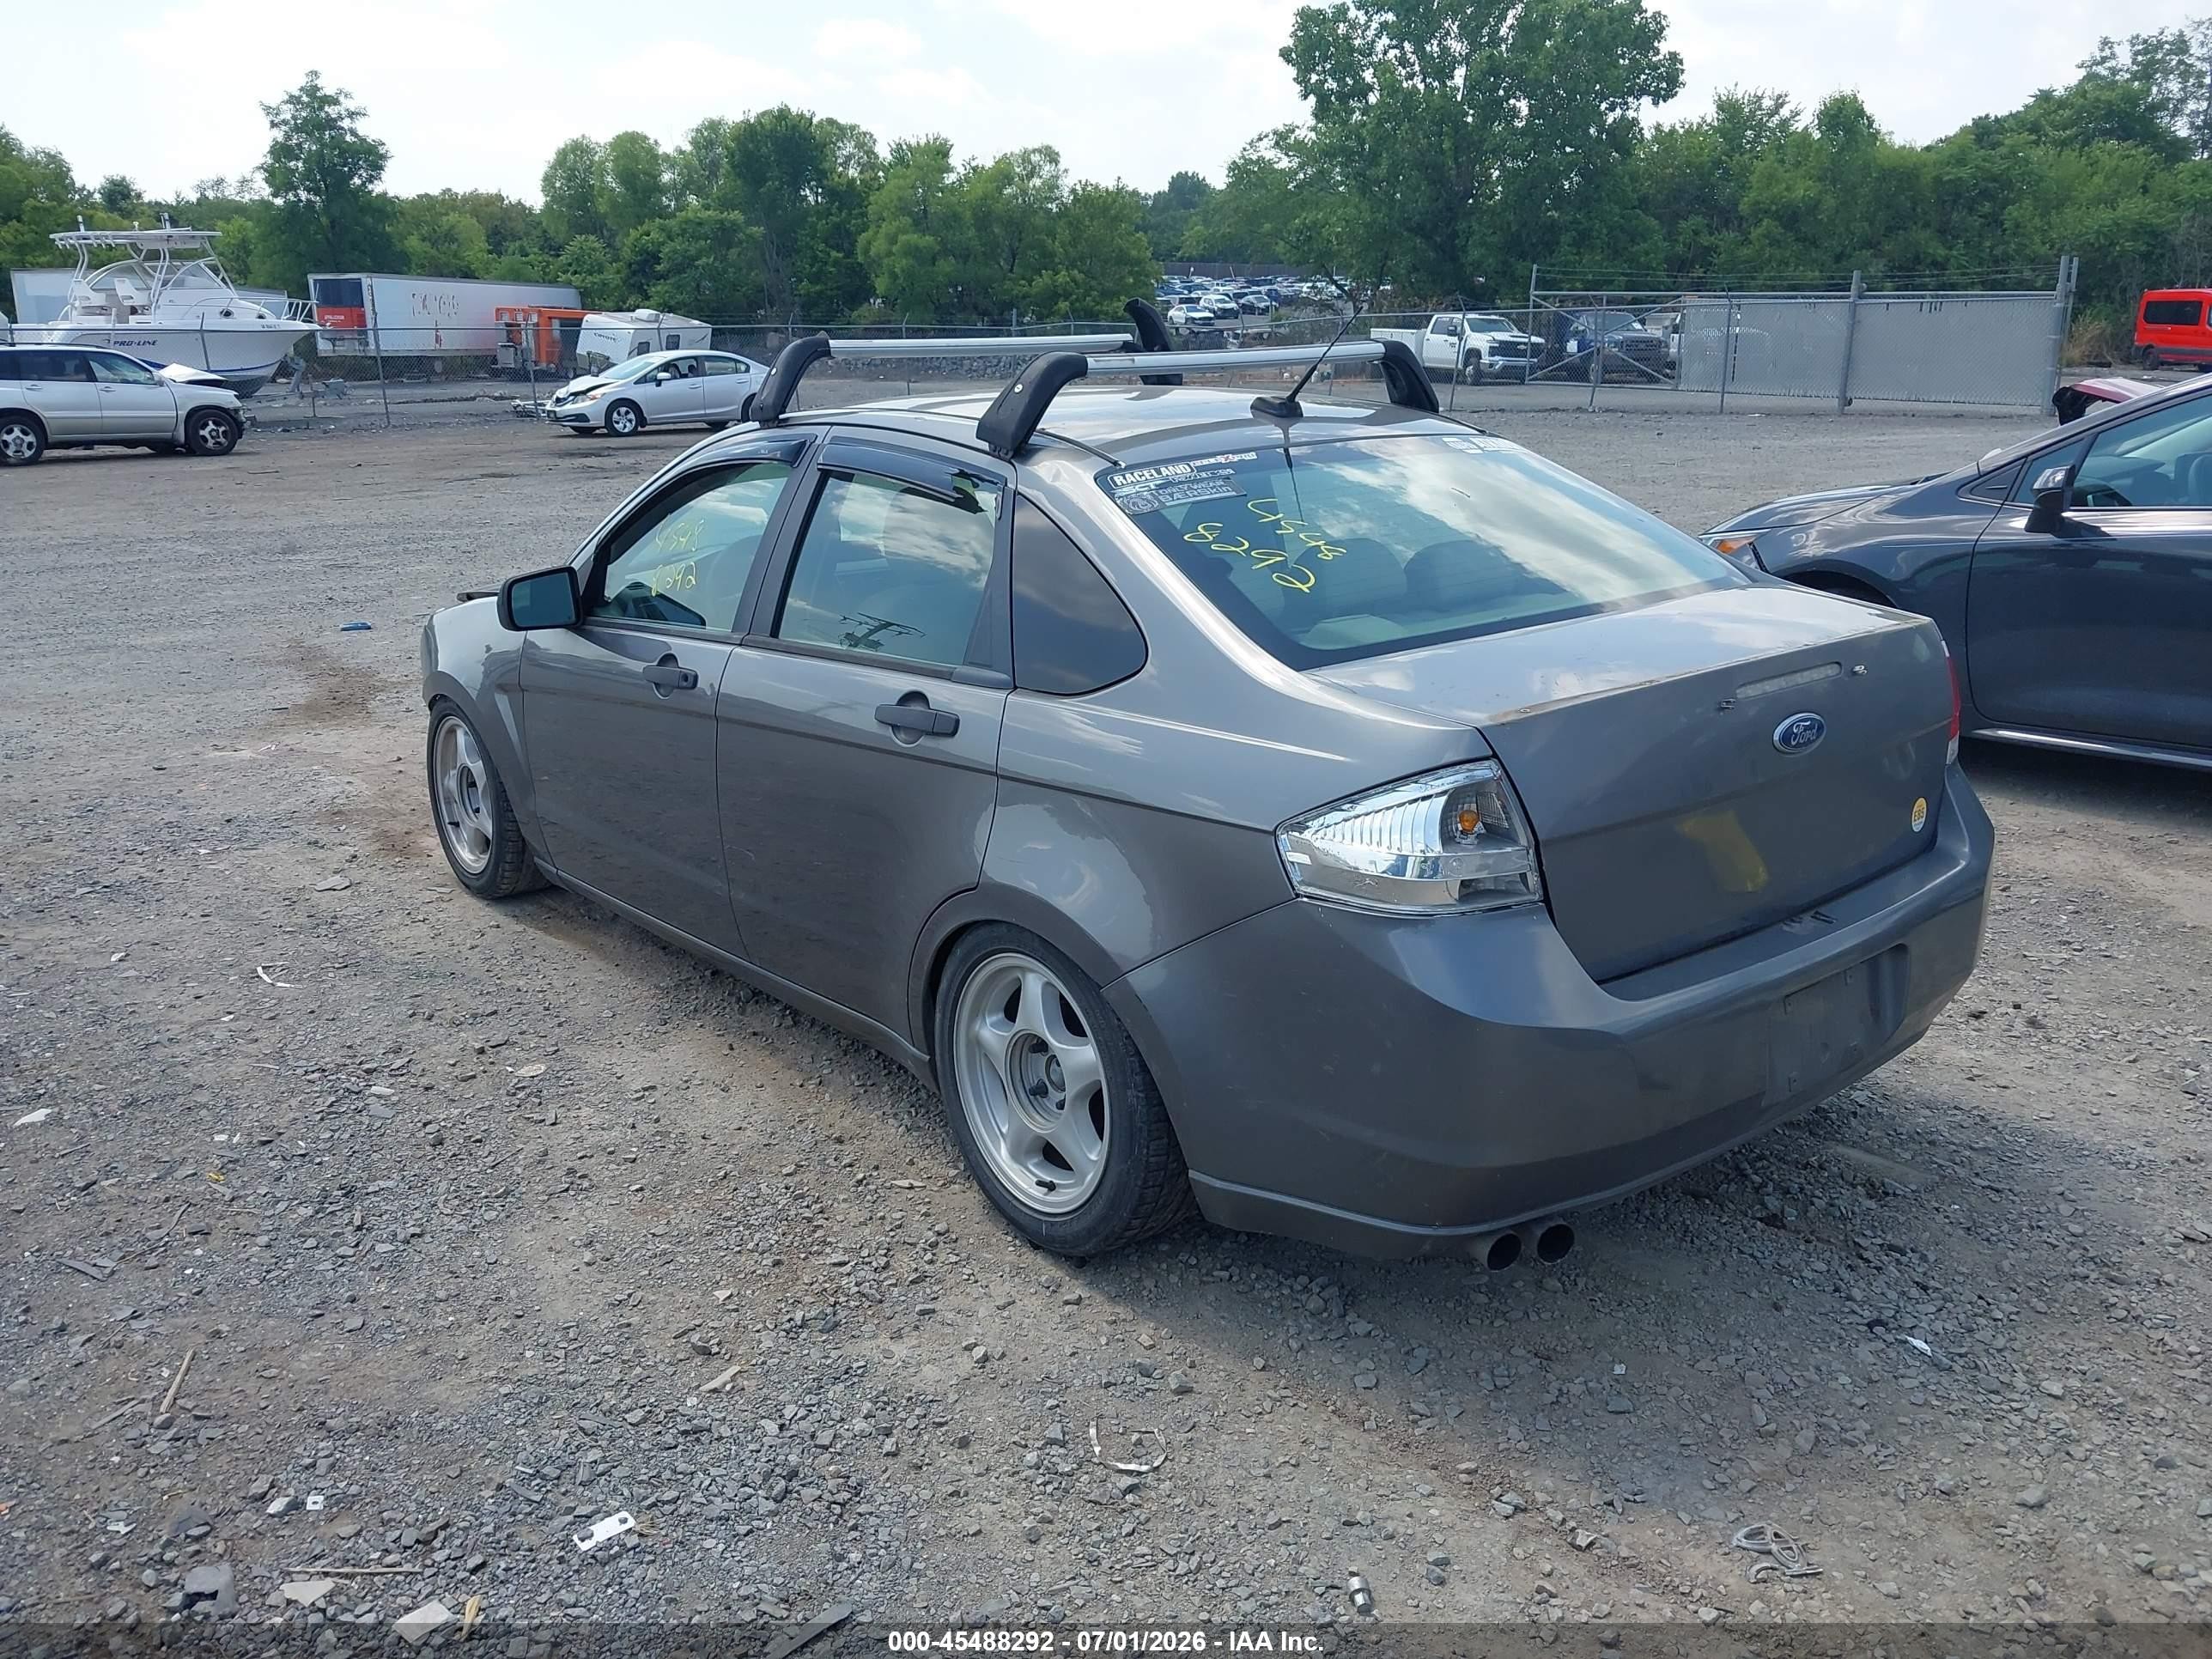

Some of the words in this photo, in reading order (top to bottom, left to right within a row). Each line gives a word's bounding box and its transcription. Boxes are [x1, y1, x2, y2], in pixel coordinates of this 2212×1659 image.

[1113, 464, 1192, 487] RACELAND
[1161, 483, 1193, 495] ONLY
[1192, 479, 1226, 489] WEAR
[1183, 522, 1316, 593] 8292
[651, 562, 696, 597] 8292
[1791, 720, 1818, 745] Ford
